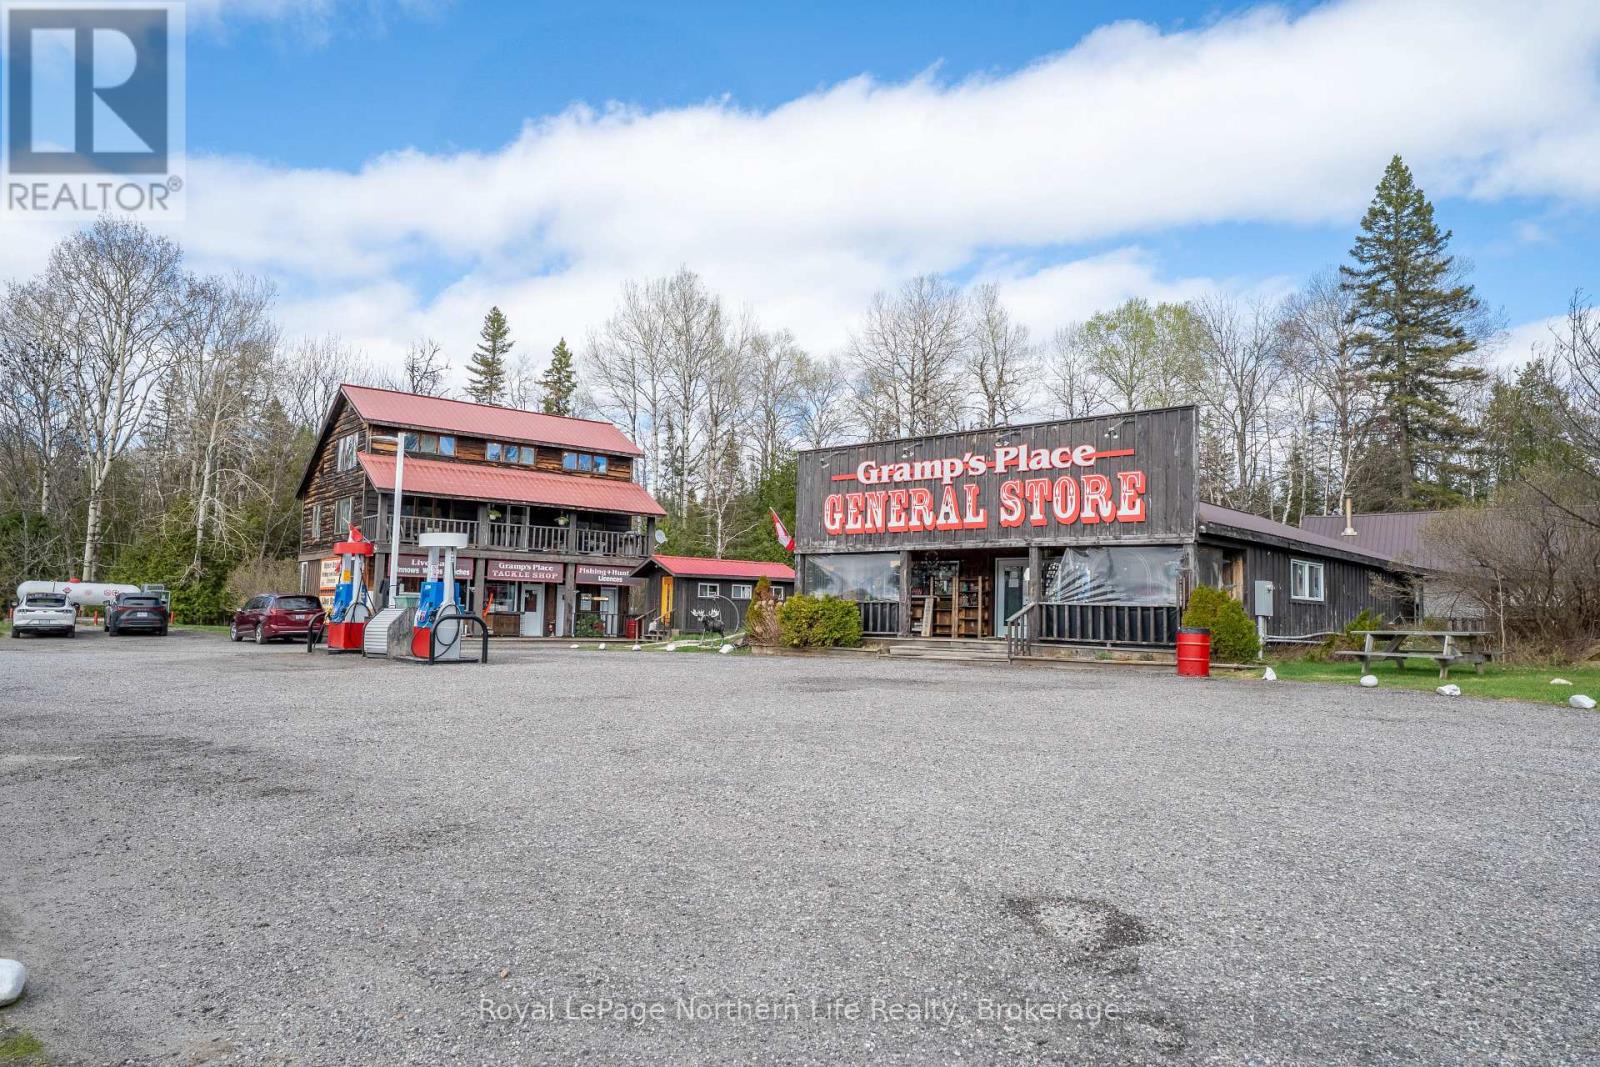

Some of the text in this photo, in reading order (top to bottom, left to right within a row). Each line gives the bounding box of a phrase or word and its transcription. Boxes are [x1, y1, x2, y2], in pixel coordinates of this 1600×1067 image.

[856, 445, 1097, 485] Gramp's Place
[824, 471, 1146, 536] GENERAL STORE
[498, 562, 554, 572] Gramp's Place
[578, 567, 607, 576] Fishing
[492, 570, 559, 580] TACKLE SHOP
